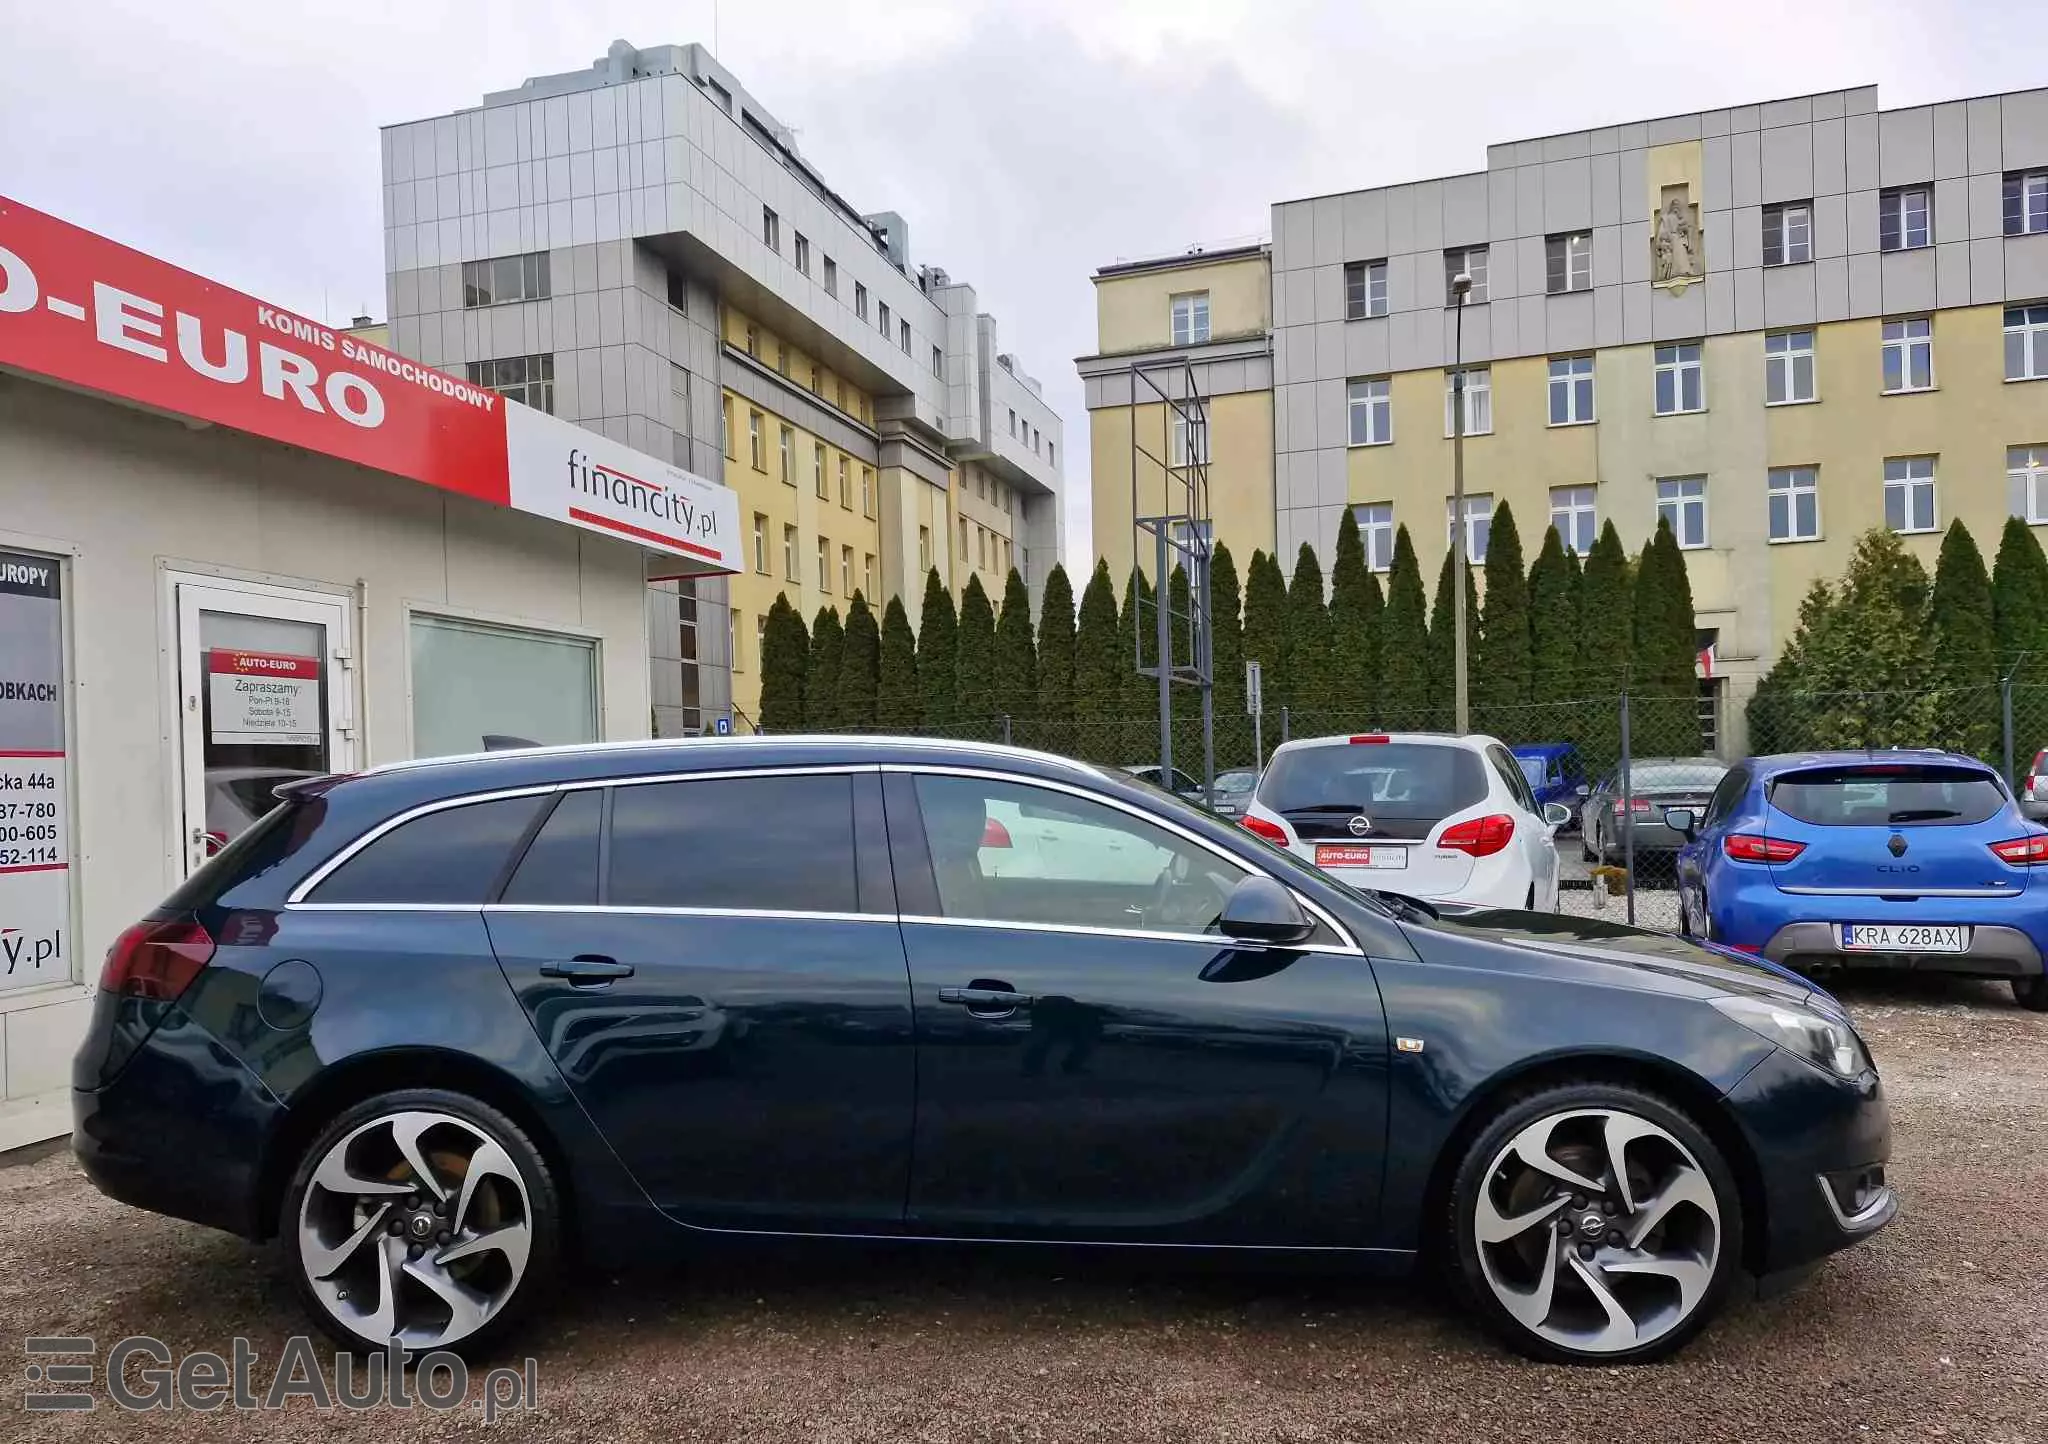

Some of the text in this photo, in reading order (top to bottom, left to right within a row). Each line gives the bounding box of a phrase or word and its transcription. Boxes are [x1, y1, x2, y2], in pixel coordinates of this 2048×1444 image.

[258, 305, 494, 412] KOMIS SAMOCHODOWY
[568, 449, 717, 538] financity.pl
[239, 657, 297, 671] AUTO-EURO
[28, 772, 55, 790] 44a
[0, 847, 57, 865] 52-114
[1320, 852, 1369, 860] AUTO-EURO
[1877, 865, 1921, 873] CLIO
[1854, 927, 1892, 945] KRA
[1897, 928, 1959, 946] 628AX
